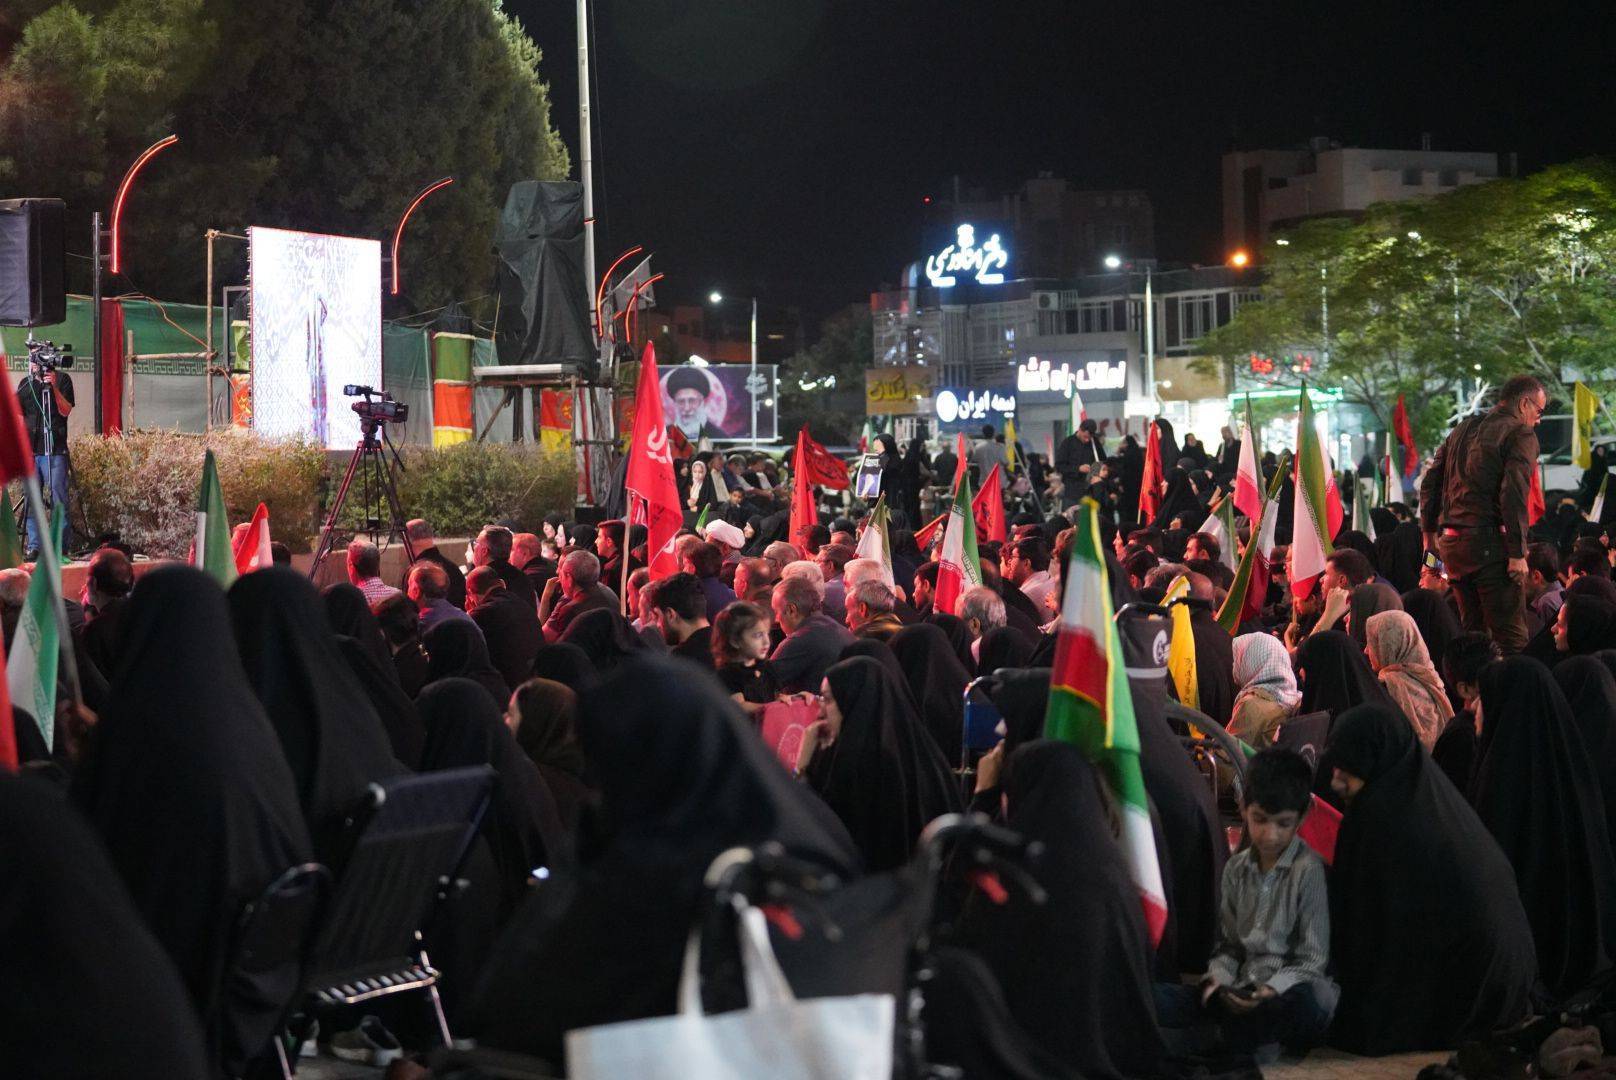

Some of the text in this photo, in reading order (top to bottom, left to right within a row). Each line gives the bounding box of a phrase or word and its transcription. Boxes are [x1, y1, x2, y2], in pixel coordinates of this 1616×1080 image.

[1076, 361, 1126, 389] املاک
[958, 390, 1016, 419] بیمه ایران
